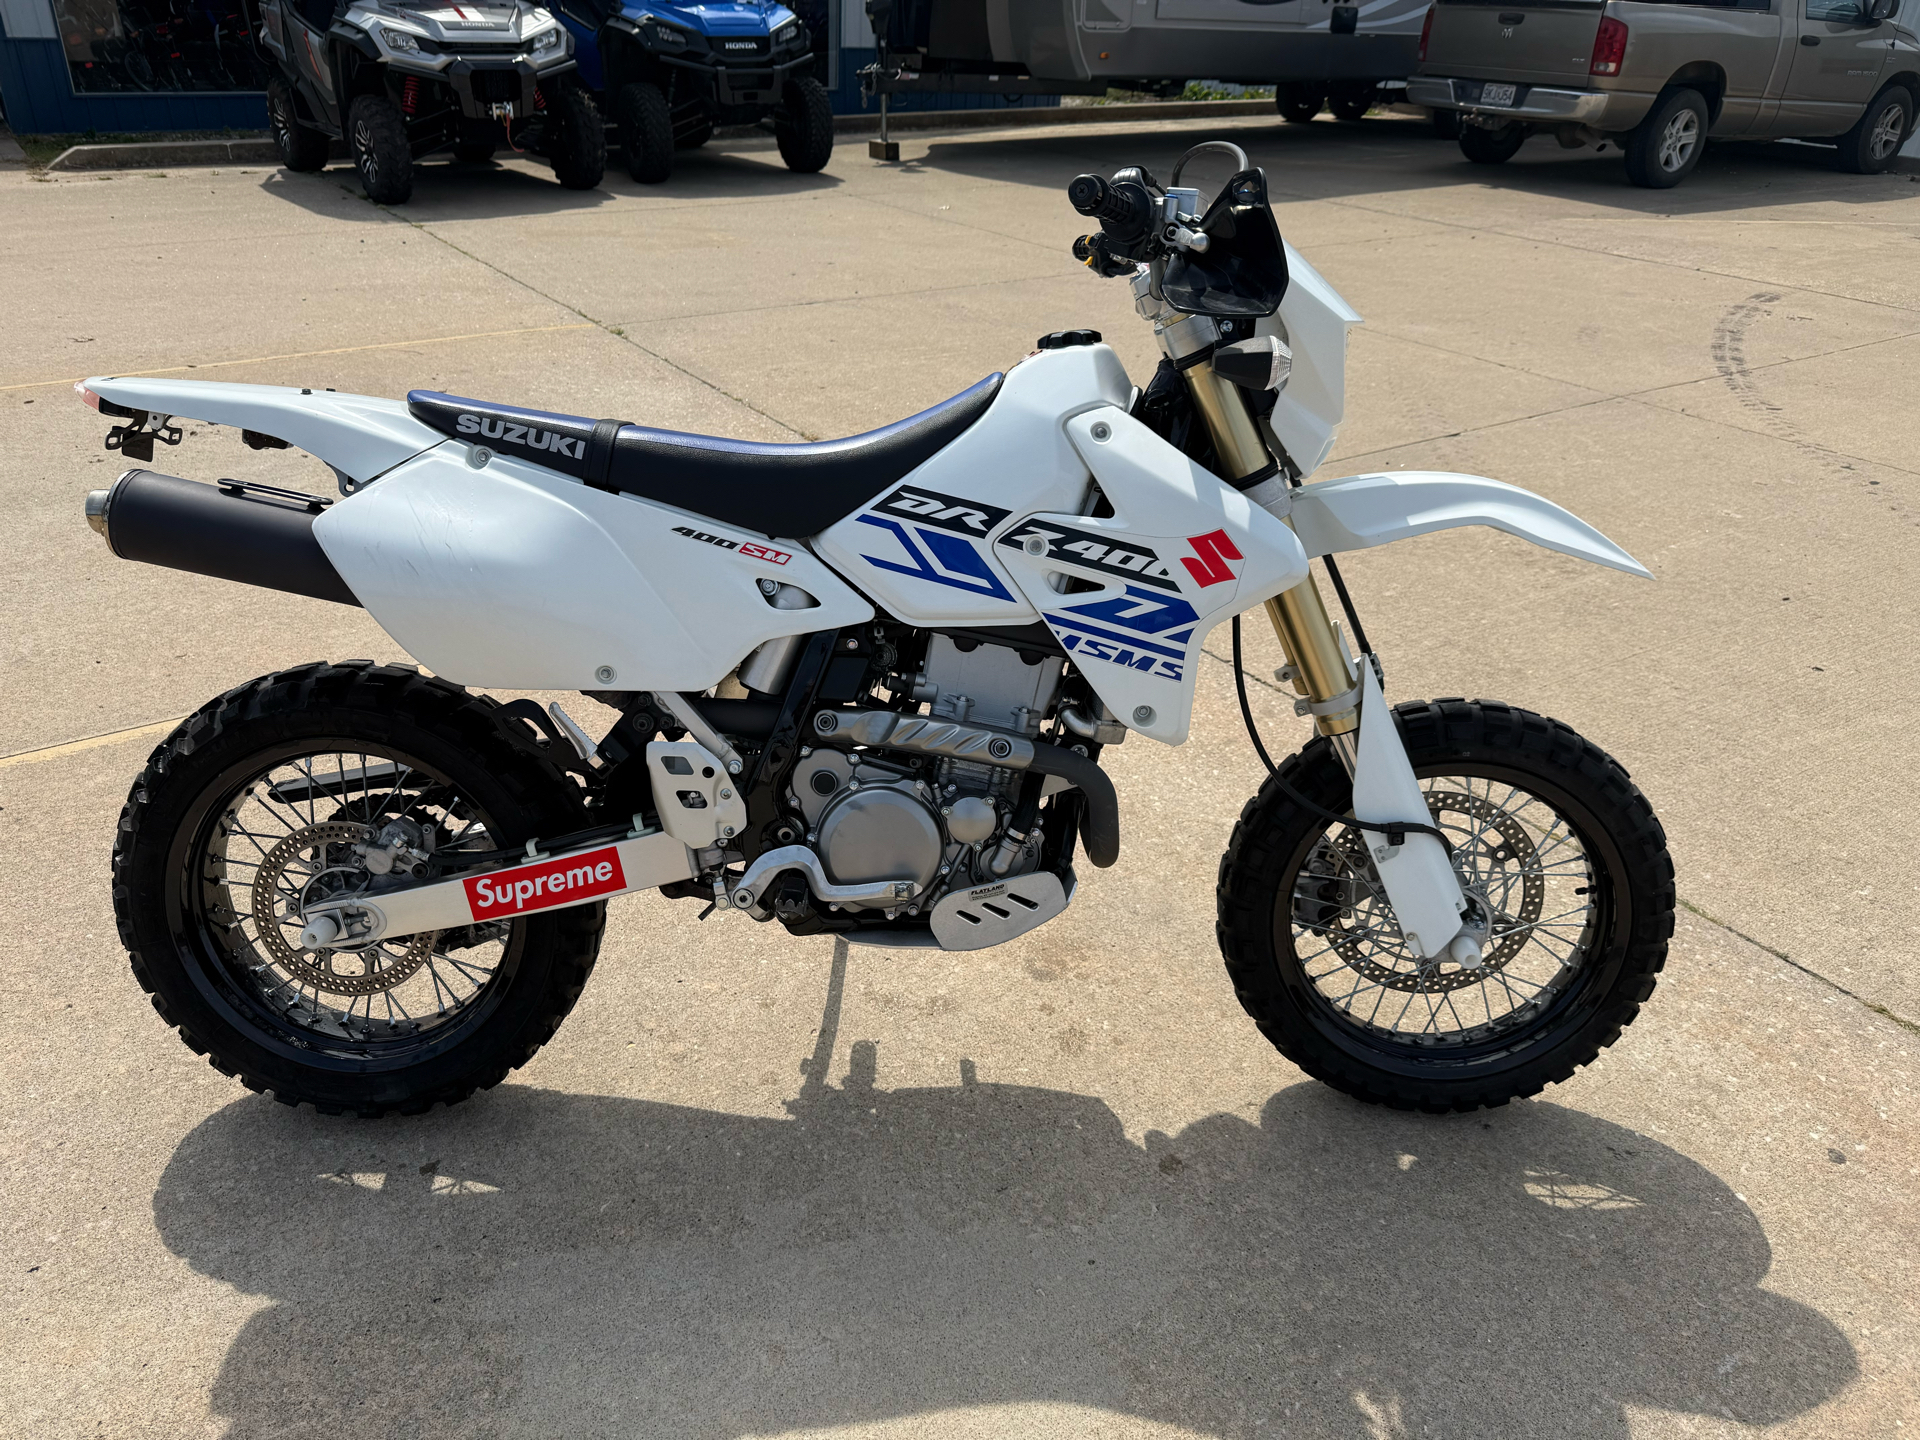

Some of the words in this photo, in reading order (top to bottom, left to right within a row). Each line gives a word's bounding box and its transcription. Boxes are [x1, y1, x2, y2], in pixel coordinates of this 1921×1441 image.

[724, 41, 758, 50] HONDA
[456, 414, 586, 461] SUZUKI
[887, 490, 991, 531] DR
[476, 861, 613, 909] Supreme
[970, 883, 1005, 896] FLATLAND
